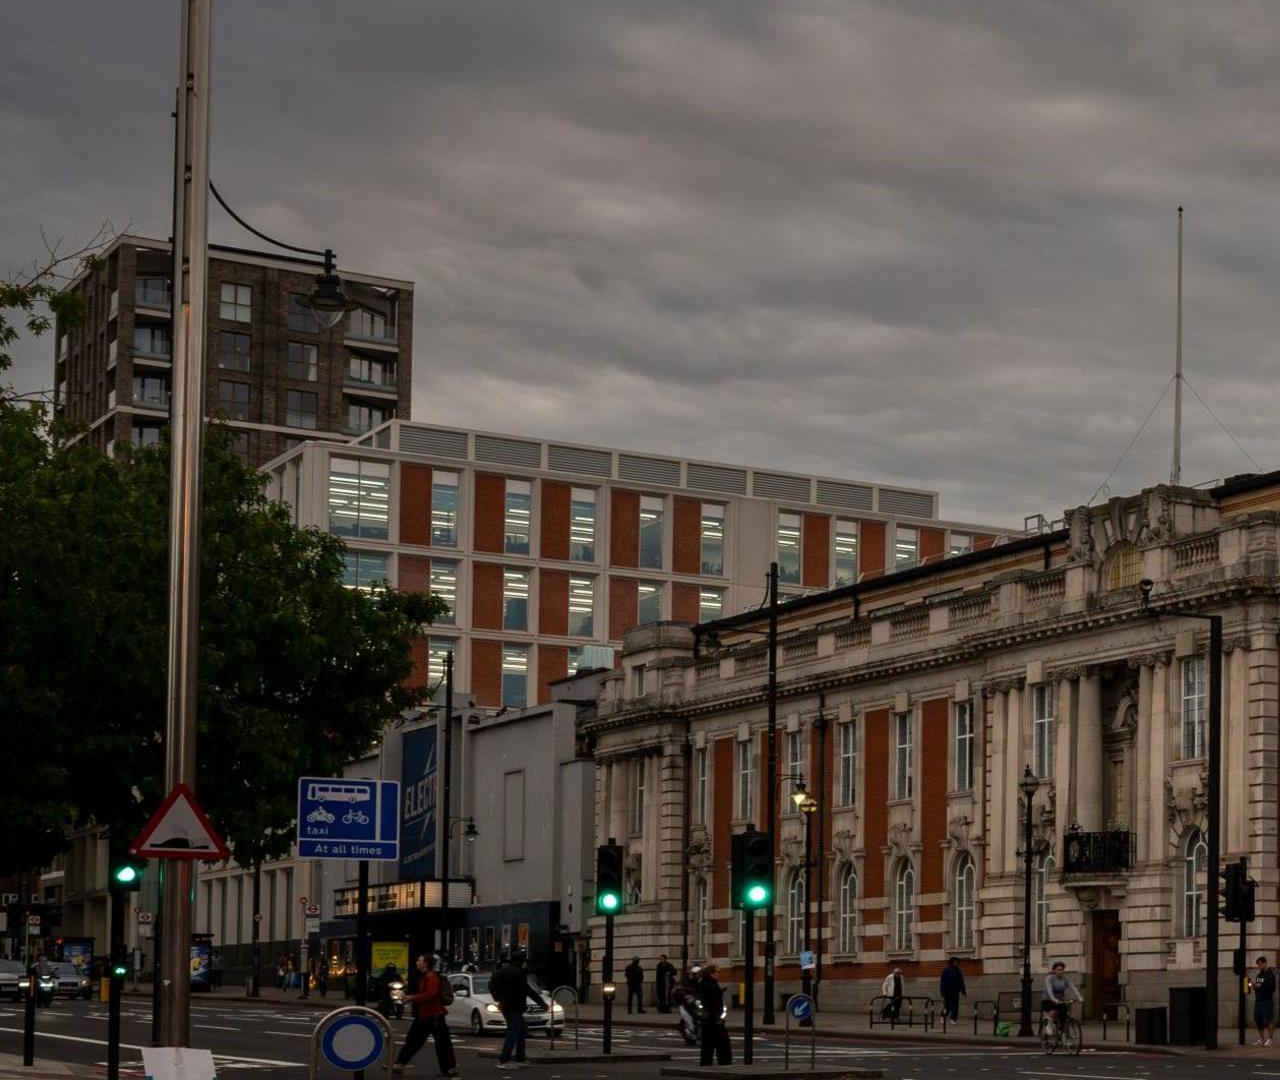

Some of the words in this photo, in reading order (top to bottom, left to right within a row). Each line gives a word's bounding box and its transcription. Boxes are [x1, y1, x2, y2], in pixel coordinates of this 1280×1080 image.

[306, 825, 329, 835] taxi
[314, 844, 329, 854] At
[331, 844, 347, 854] all
[350, 845, 382, 855] times
